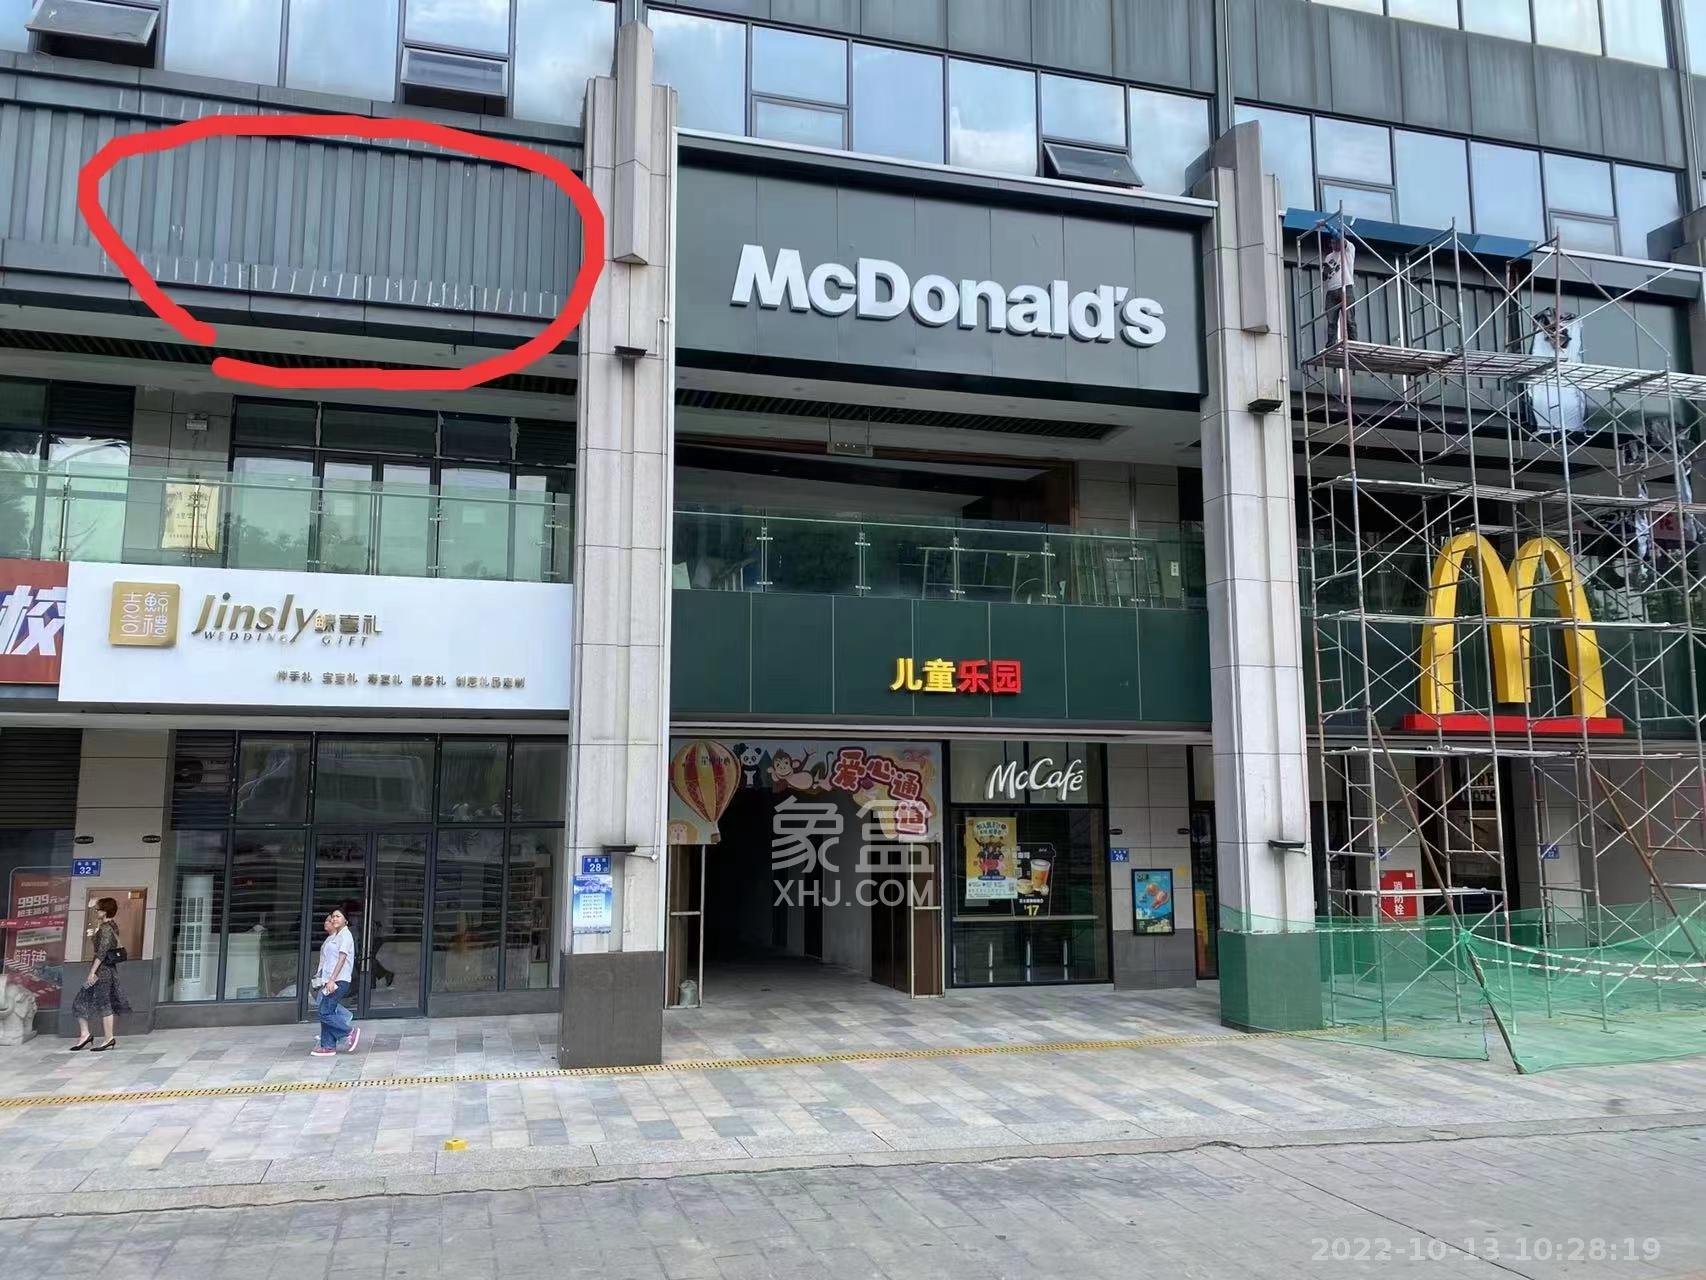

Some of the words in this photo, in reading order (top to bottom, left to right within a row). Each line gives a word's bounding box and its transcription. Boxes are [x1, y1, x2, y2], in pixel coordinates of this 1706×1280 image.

[731, 243, 1166, 348] McDonald's
[192, 592, 317, 644] Jinsly
[204, 631, 288, 642] WEDDING
[321, 636, 368, 648] GIFT
[890, 657, 1022, 694] 儿童乐园
[831, 746, 928, 834] 爱心通道
[988, 757, 1084, 801] McCafé
[79, 866, 92, 875] 32
[590, 863, 602, 873] 28
